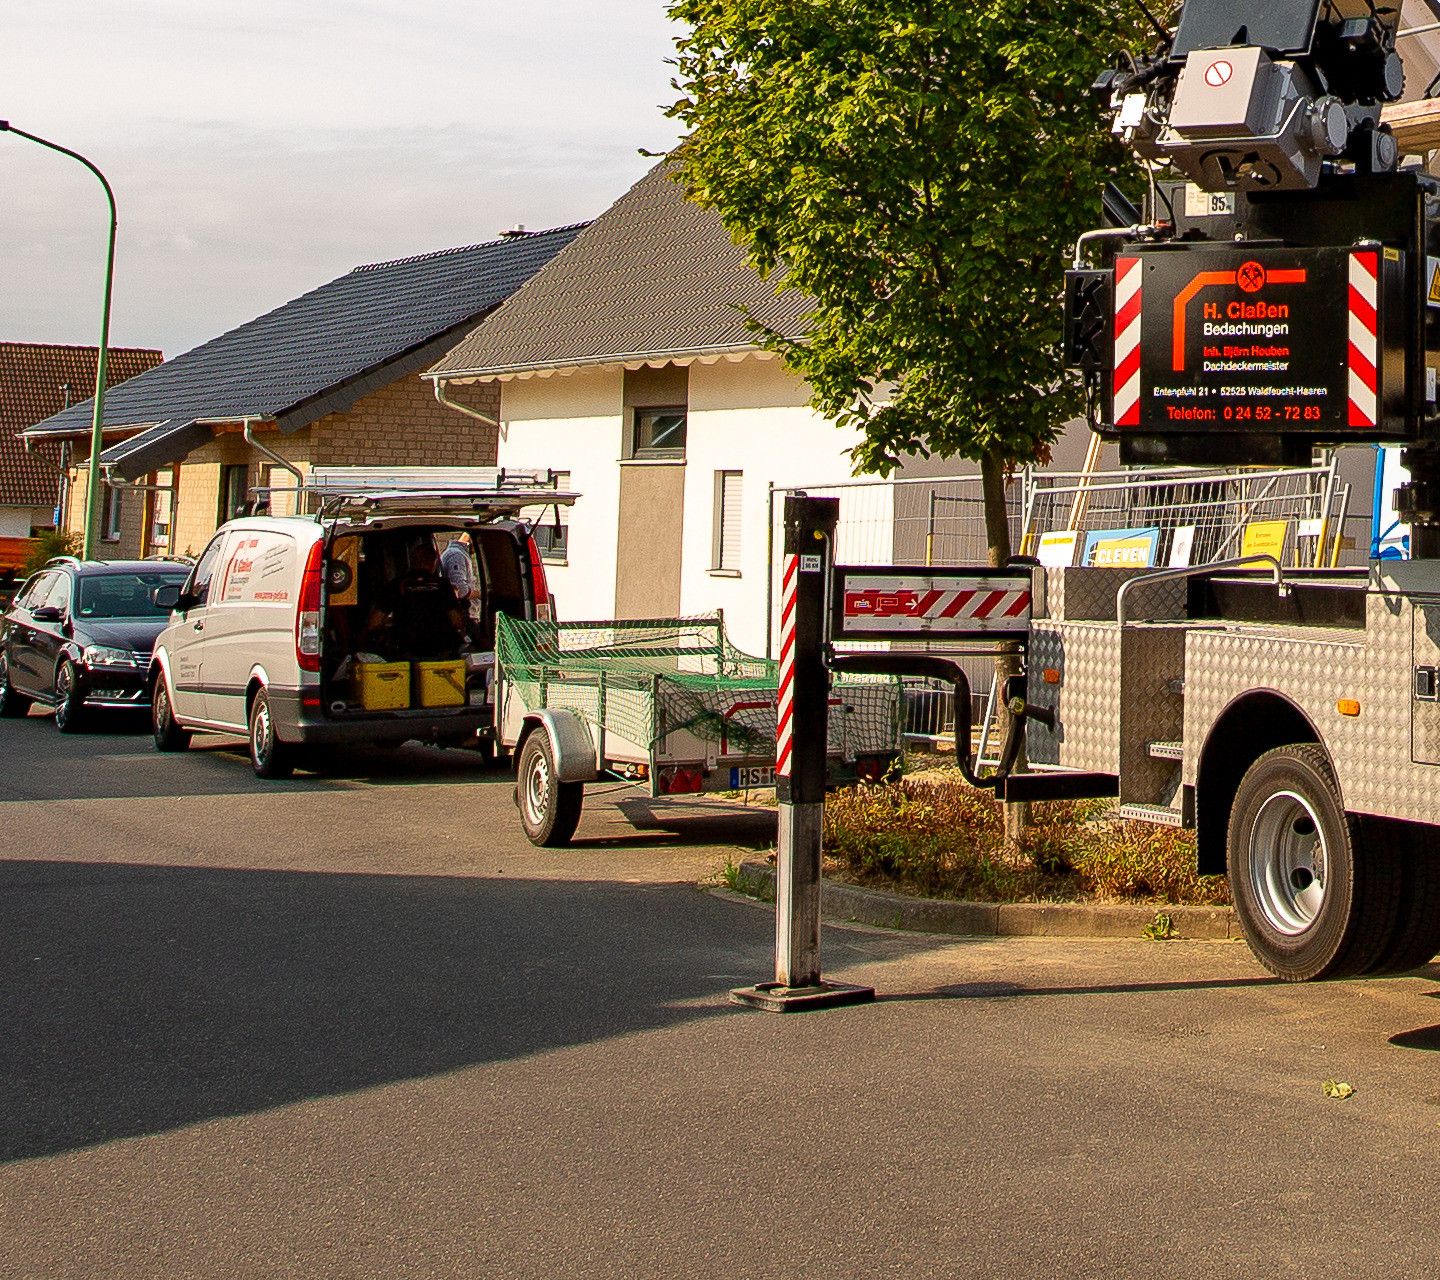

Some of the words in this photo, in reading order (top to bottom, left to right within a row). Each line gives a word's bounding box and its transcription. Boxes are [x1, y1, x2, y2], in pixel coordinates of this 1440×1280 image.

[1211, 196, 1226, 212] 95
[1203, 303, 1222, 319] H.
[1227, 302, 1289, 319] Claßen
[1203, 322, 1289, 338] Bedachungen
[1251, 346, 1290, 357] Houben
[1203, 361, 1289, 371] Dachdeckermeister
[1153, 387, 1197, 397] Entenpfuhl
[1198, 387, 1209, 396] 21
[1220, 387, 1246, 396] 52525
[1248, 386, 1328, 396] Waldfeucht-Haaren
[1166, 406, 1216, 420] Telefon:
[1223, 406, 1232, 420] 0
[1235, 406, 1251, 420] 24
[1255, 407, 1272, 419] 52
[1285, 406, 1301, 419] 72
[1304, 406, 1321, 419] 83
[1097, 546, 1148, 564] CLEVEN
[740, 768, 760, 786] HS
